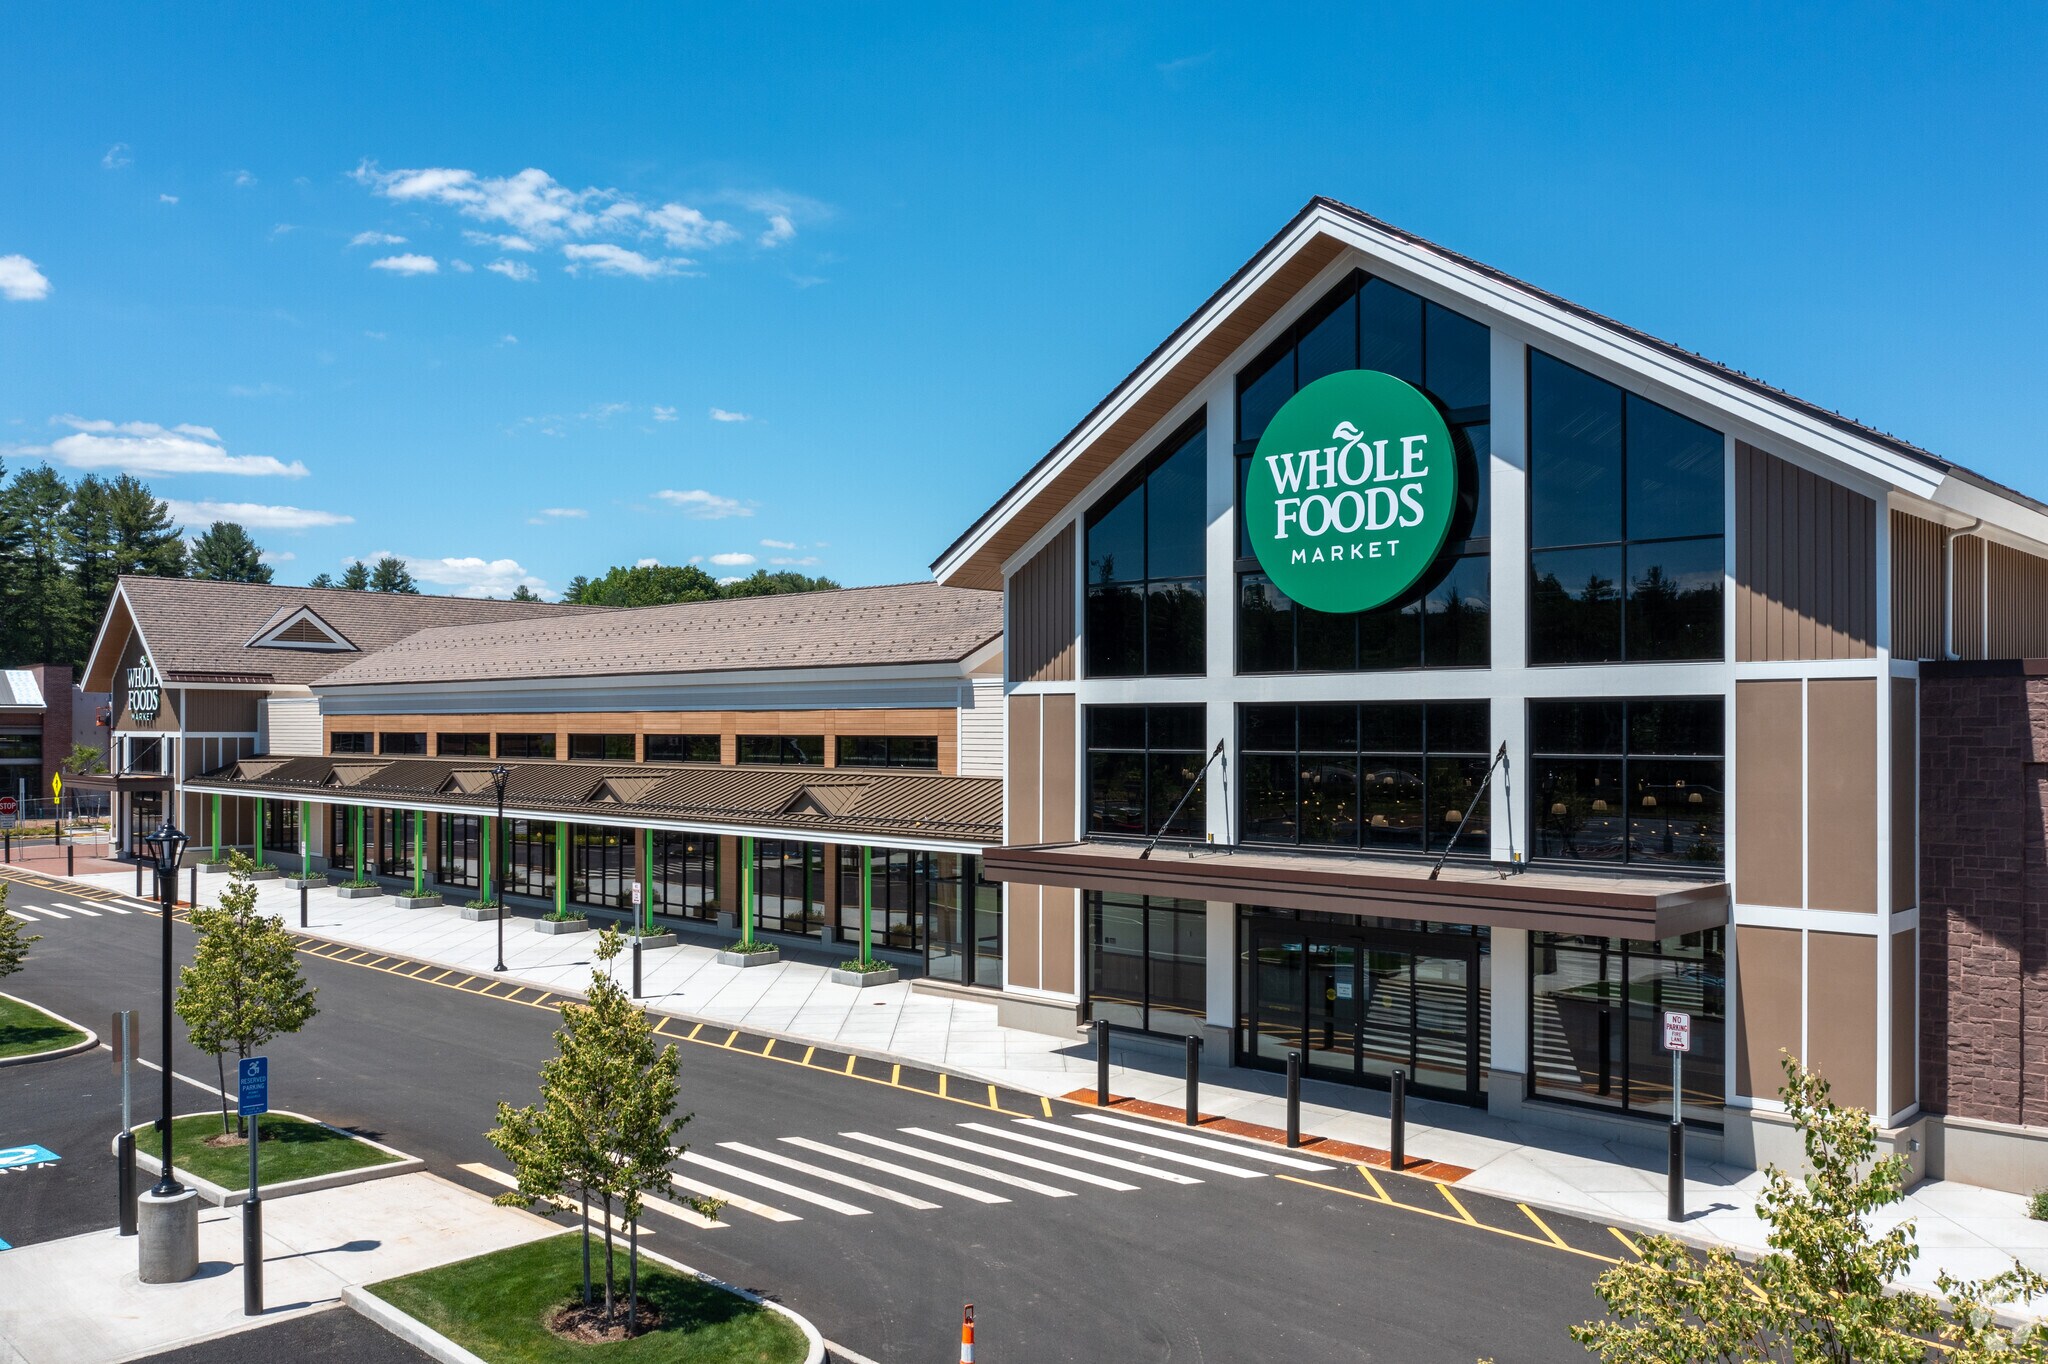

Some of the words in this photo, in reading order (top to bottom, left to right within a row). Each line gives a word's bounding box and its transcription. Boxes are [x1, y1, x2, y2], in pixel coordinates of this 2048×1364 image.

[1265, 429, 1429, 495] WHOLE
[1274, 482, 1425, 540] FOODS
[1291, 540, 1400, 565] MARKET
[128, 690, 158, 711] FOODS
[131, 712, 154, 721] MARKET
[0, 802, 17, 810] STOP
[1672, 1015, 1682, 1024] NO
[1666, 1023, 1688, 1032] PARKING
[240, 1076, 267, 1085] RESERVED
[242, 1083, 265, 1091] PARKING
